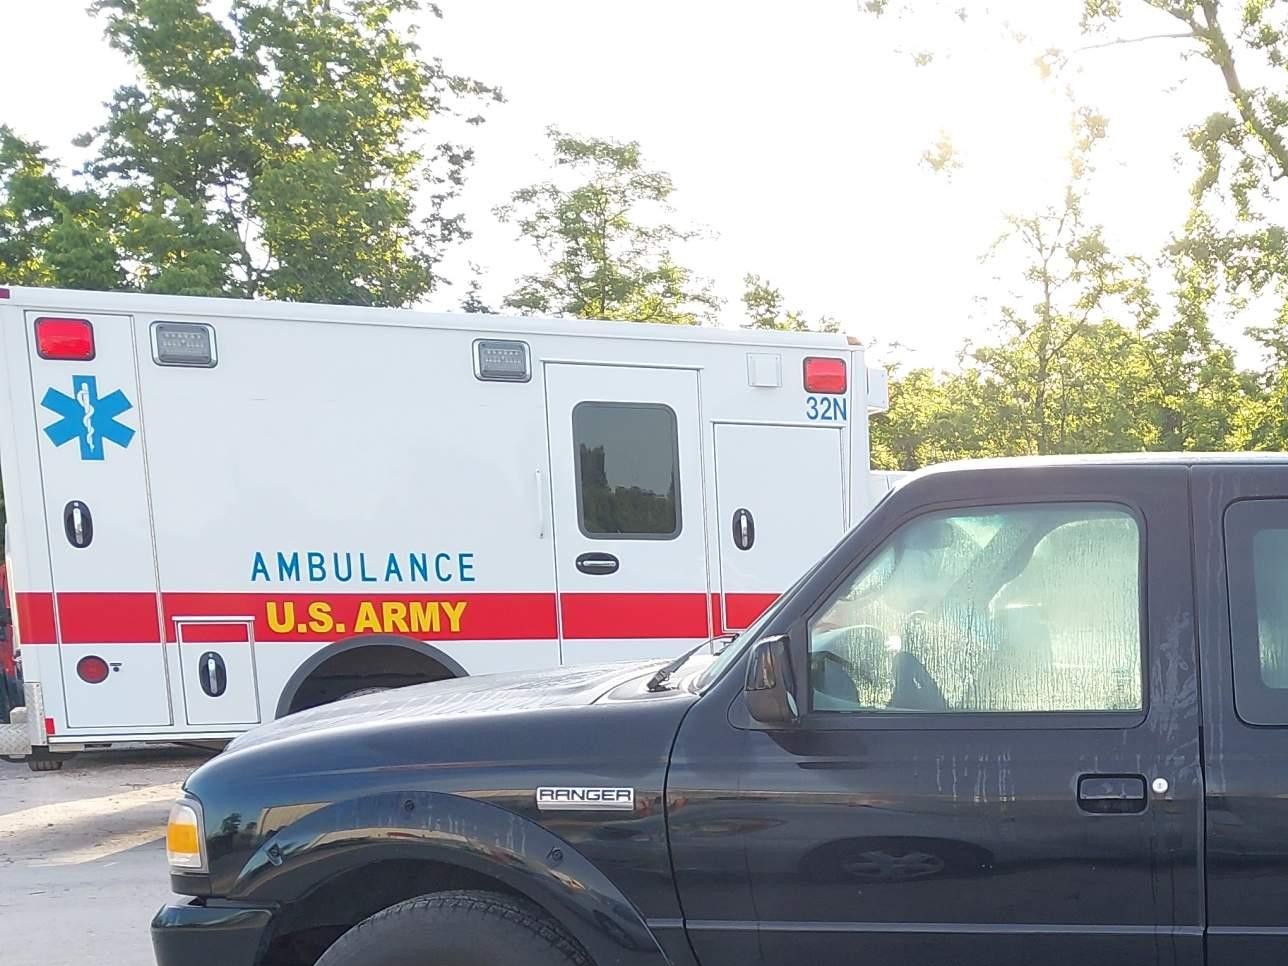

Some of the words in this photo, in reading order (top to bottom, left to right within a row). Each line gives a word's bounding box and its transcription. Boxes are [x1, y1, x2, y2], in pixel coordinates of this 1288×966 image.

[806, 396, 847, 421] 32N
[250, 552, 476, 582] AMBULANCE
[266, 601, 346, 633] U.S.
[354, 601, 467, 633] ARMY
[539, 789, 632, 801] RANGER
